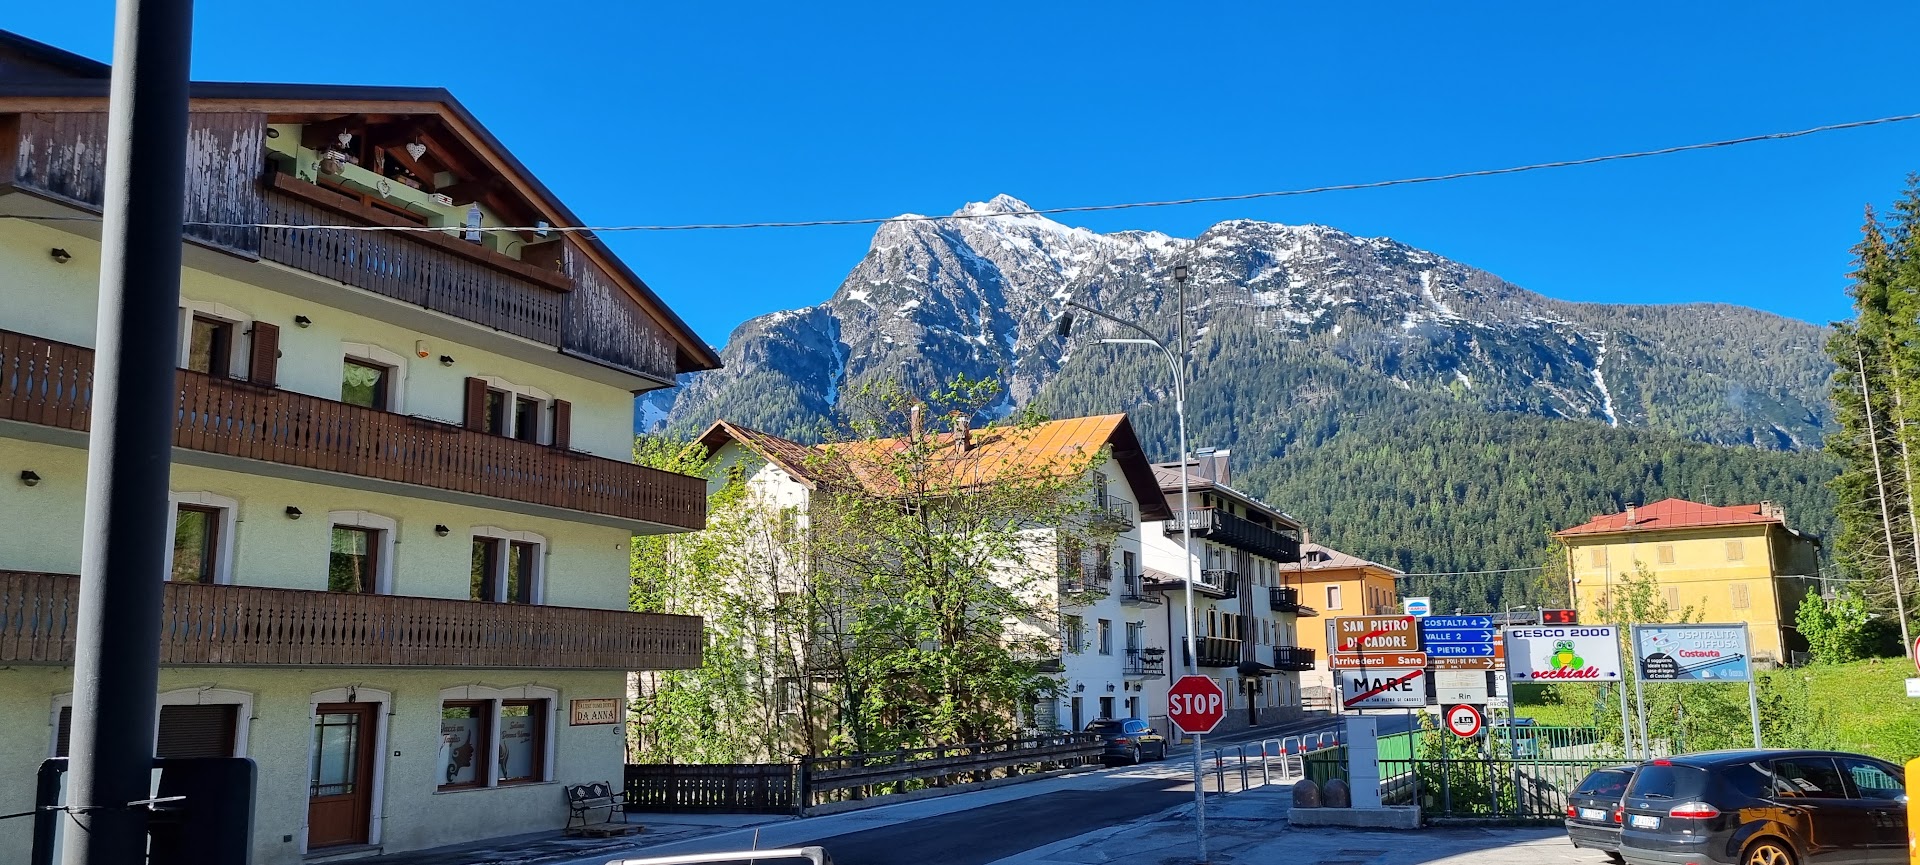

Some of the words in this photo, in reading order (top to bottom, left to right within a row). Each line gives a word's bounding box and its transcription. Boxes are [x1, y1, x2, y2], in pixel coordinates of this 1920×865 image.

[1342, 620, 1364, 632] SAN
[1370, 620, 1409, 631] PIETRO
[1512, 629, 1565, 638] CESCO
[1570, 628, 1610, 637] 2000
[1346, 637, 1358, 648] DI
[1364, 636, 1408, 648] CADORE
[1693, 640, 1740, 648] DIFFUSA
[1334, 657, 1384, 665] Arrivederci
[1397, 656, 1422, 665] Sane
[1530, 665, 1600, 679] occhiali
[1720, 668, 1727, 677] 4
[1353, 677, 1413, 692] MARE
[1170, 693, 1221, 715] STOP
[577, 711, 589, 720] DA
[591, 710, 614, 720] ANNA
